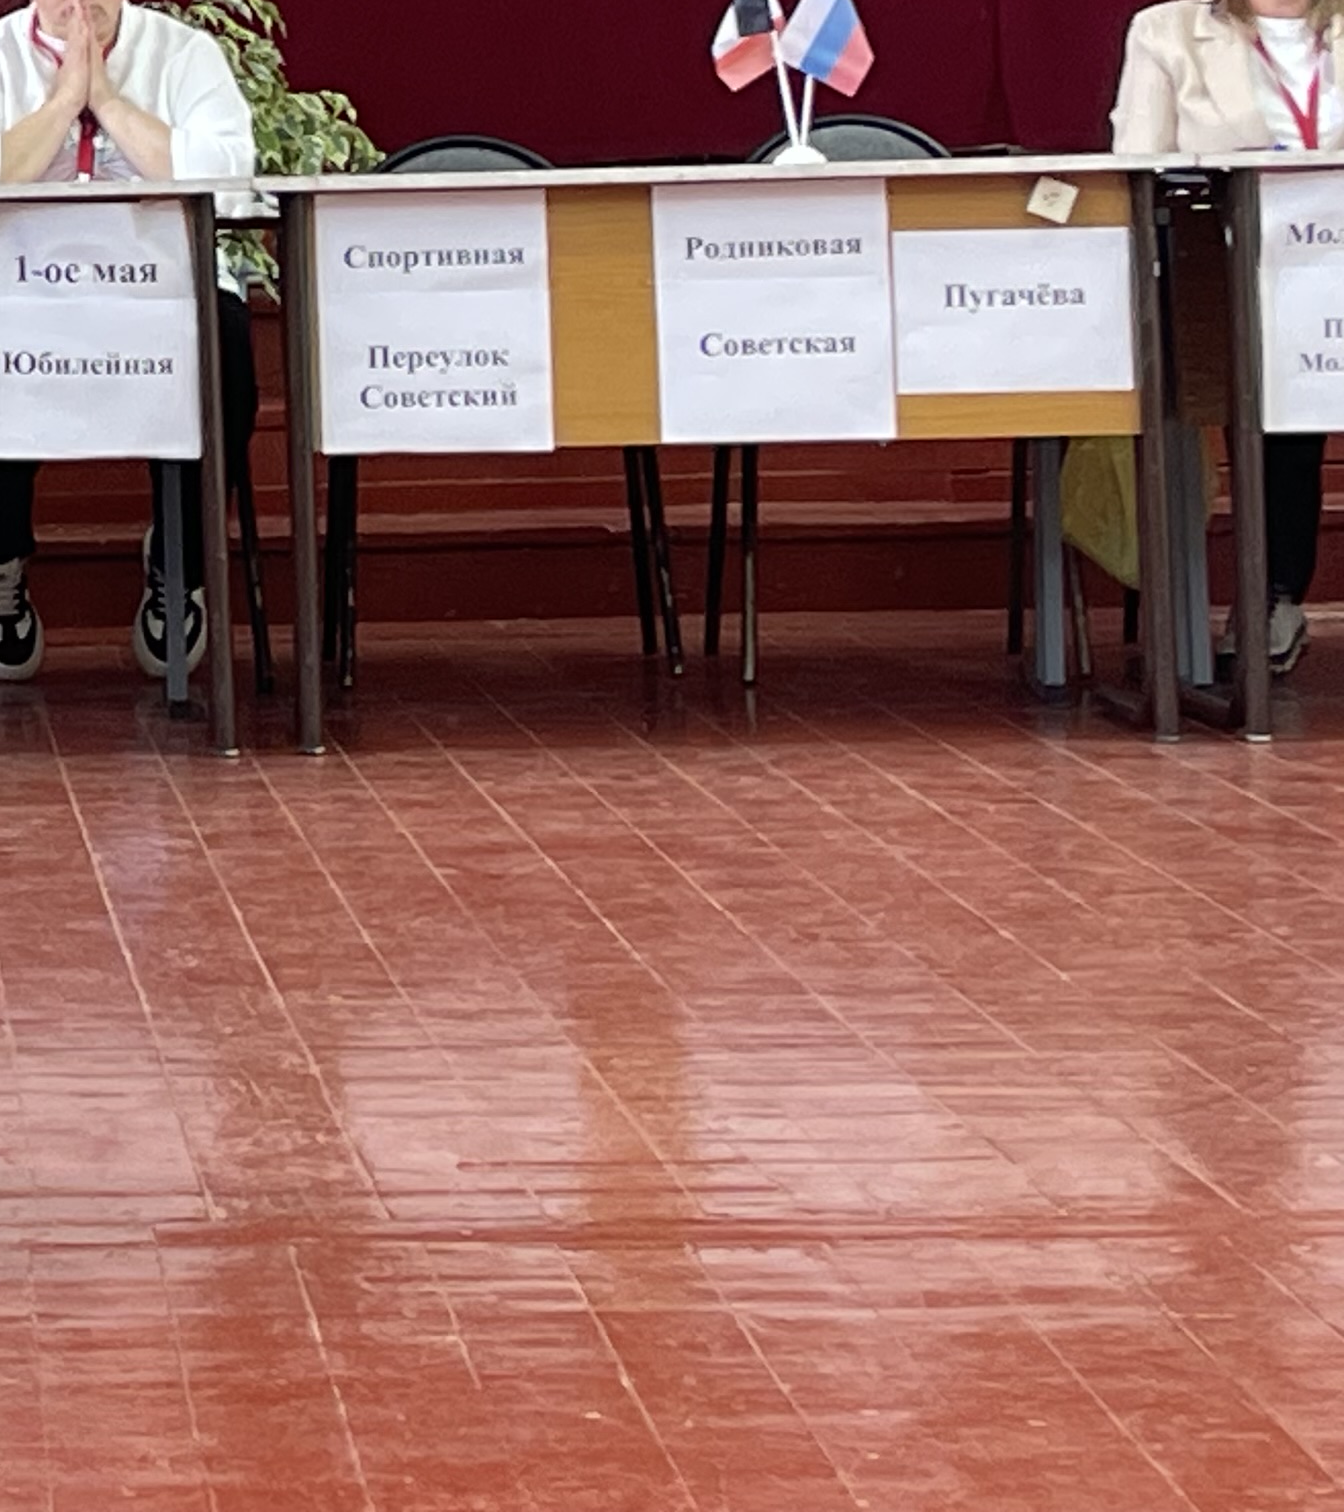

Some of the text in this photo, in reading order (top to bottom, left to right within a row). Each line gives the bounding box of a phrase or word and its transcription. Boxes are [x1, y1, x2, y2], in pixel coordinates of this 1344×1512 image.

[344, 245, 525, 274] Спортивная
[685, 237, 862, 260] Родниковая
[15, 255, 158, 283] 1-ое мая
[944, 283, 1087, 314] Пугачёва
[700, 333, 856, 357] Советская
[3, 351, 174, 375] Юбилейная
[368, 345, 510, 374] Переулок
[1299, 353, 1344, 372] Мо
[360, 379, 518, 409] Советский
